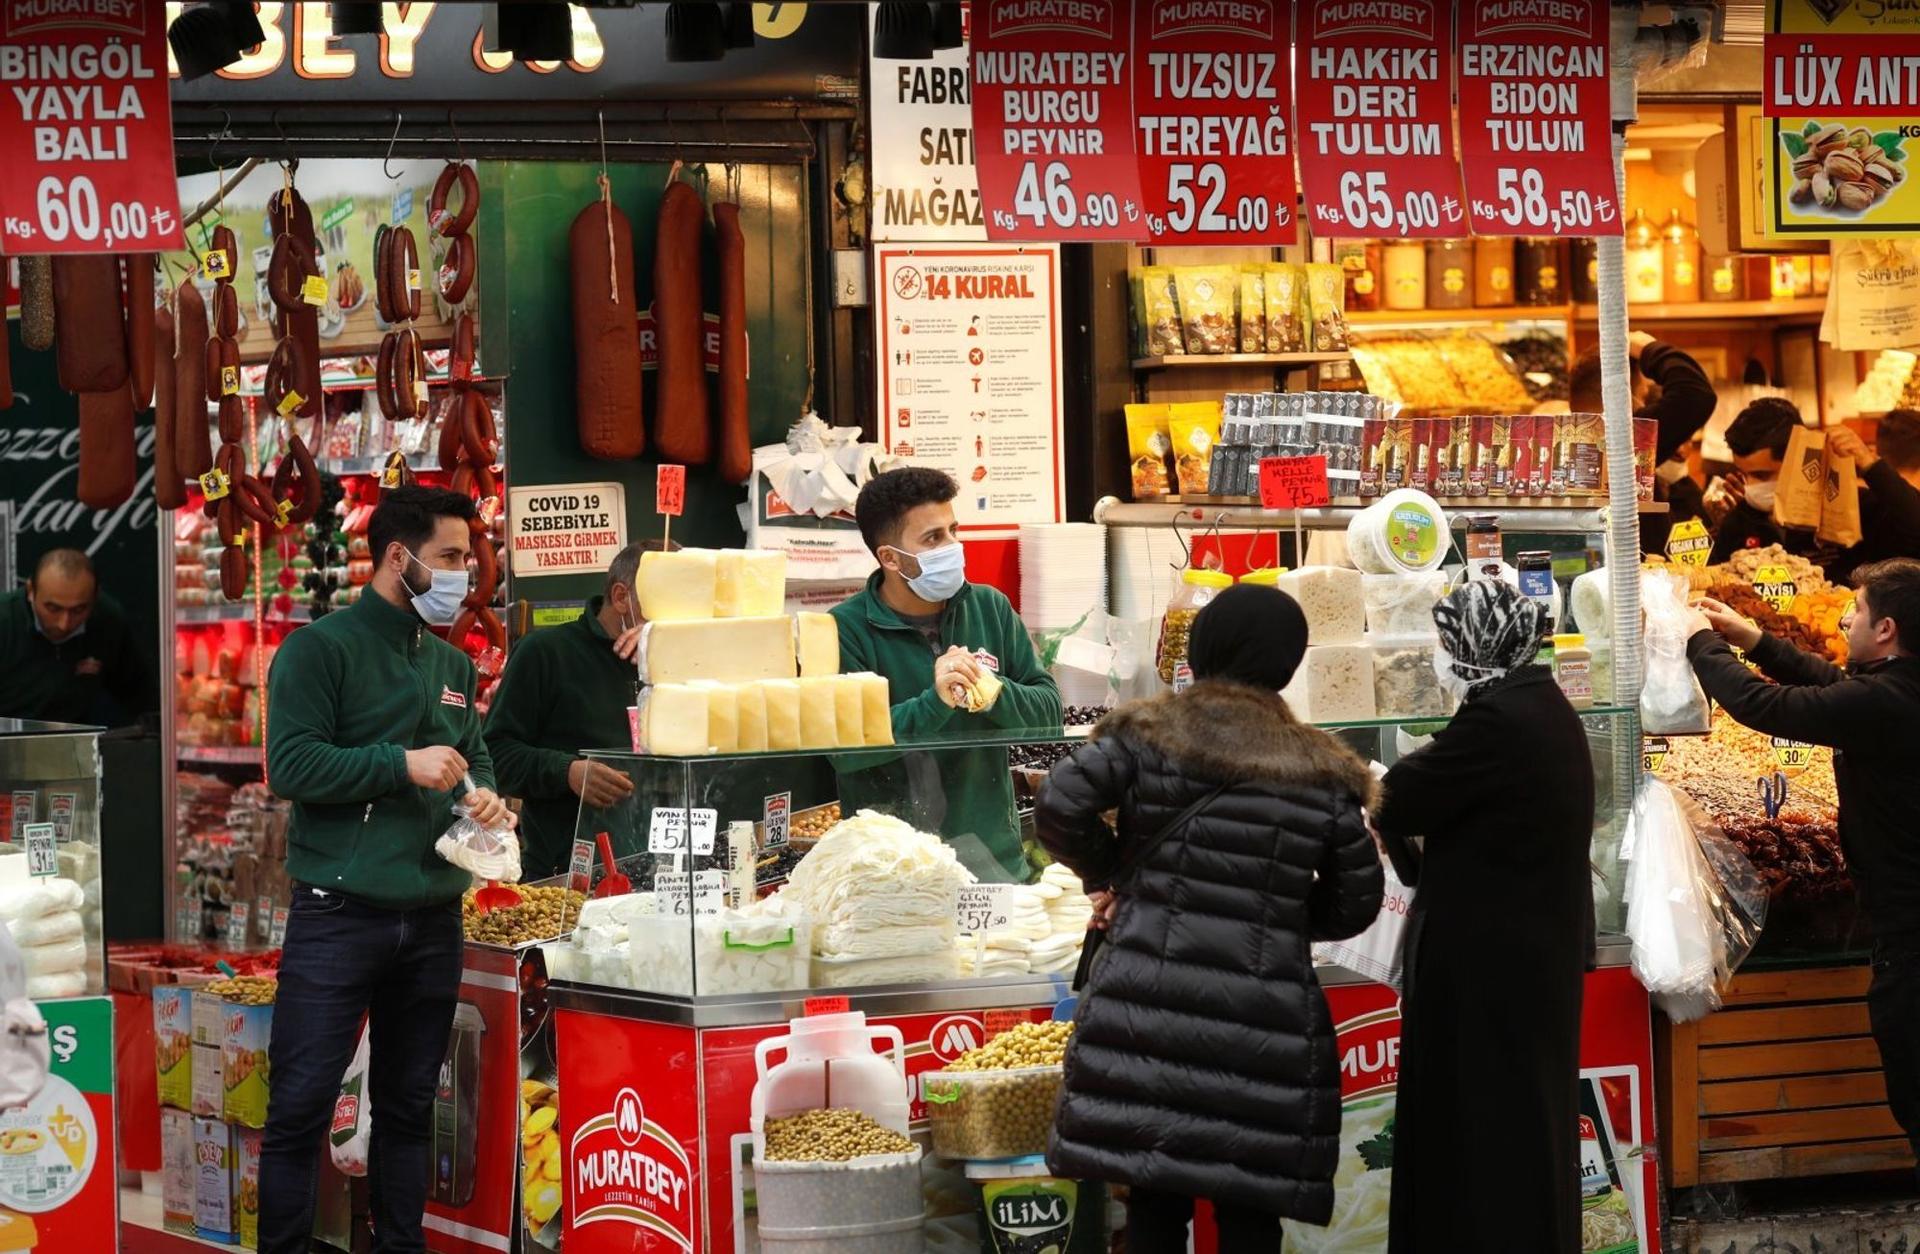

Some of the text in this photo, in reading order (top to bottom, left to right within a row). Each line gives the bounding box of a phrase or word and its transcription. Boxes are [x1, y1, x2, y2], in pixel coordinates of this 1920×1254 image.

[14, 0, 135, 21] MURATBEY
[997, 0, 1105, 23] MURATBEY
[1159, 2, 1265, 25] MURATBEY
[1321, 3, 1426, 25] MURATBEY
[1481, 2, 1584, 22] MURATBEY
[975, 52, 1126, 84] MURATBEY
[1149, 53, 1276, 99] TUZSUZ
[1774, 43, 1920, 107] LÜX ANT
[12, 85, 145, 121] YAYLA
[1003, 91, 1099, 123] BURGU
[1139, 105, 1287, 156] TEREYAĞ
[1311, 123, 1441, 155] TULUM
[1486, 120, 1584, 152] TULUM
[34, 126, 128, 161] BALI
[1316, 203, 1343, 223] Kg.
[1472, 199, 1498, 219] Kg.
[5, 217, 36, 239] Kg.
[993, 211, 1018, 231] Kg.
[955, 274, 1034, 299] KURAL
[529, 494, 600, 512] COViD 19
[521, 513, 610, 532] SEBEBiYLE
[536, 550, 593, 567] YASAKTIR
[1753, 584, 1794, 596] KAYISI
[770, 826, 782, 843] 28
[967, 910, 1007, 930] 57.50
[578, 1149, 683, 1211] MURATBEY
